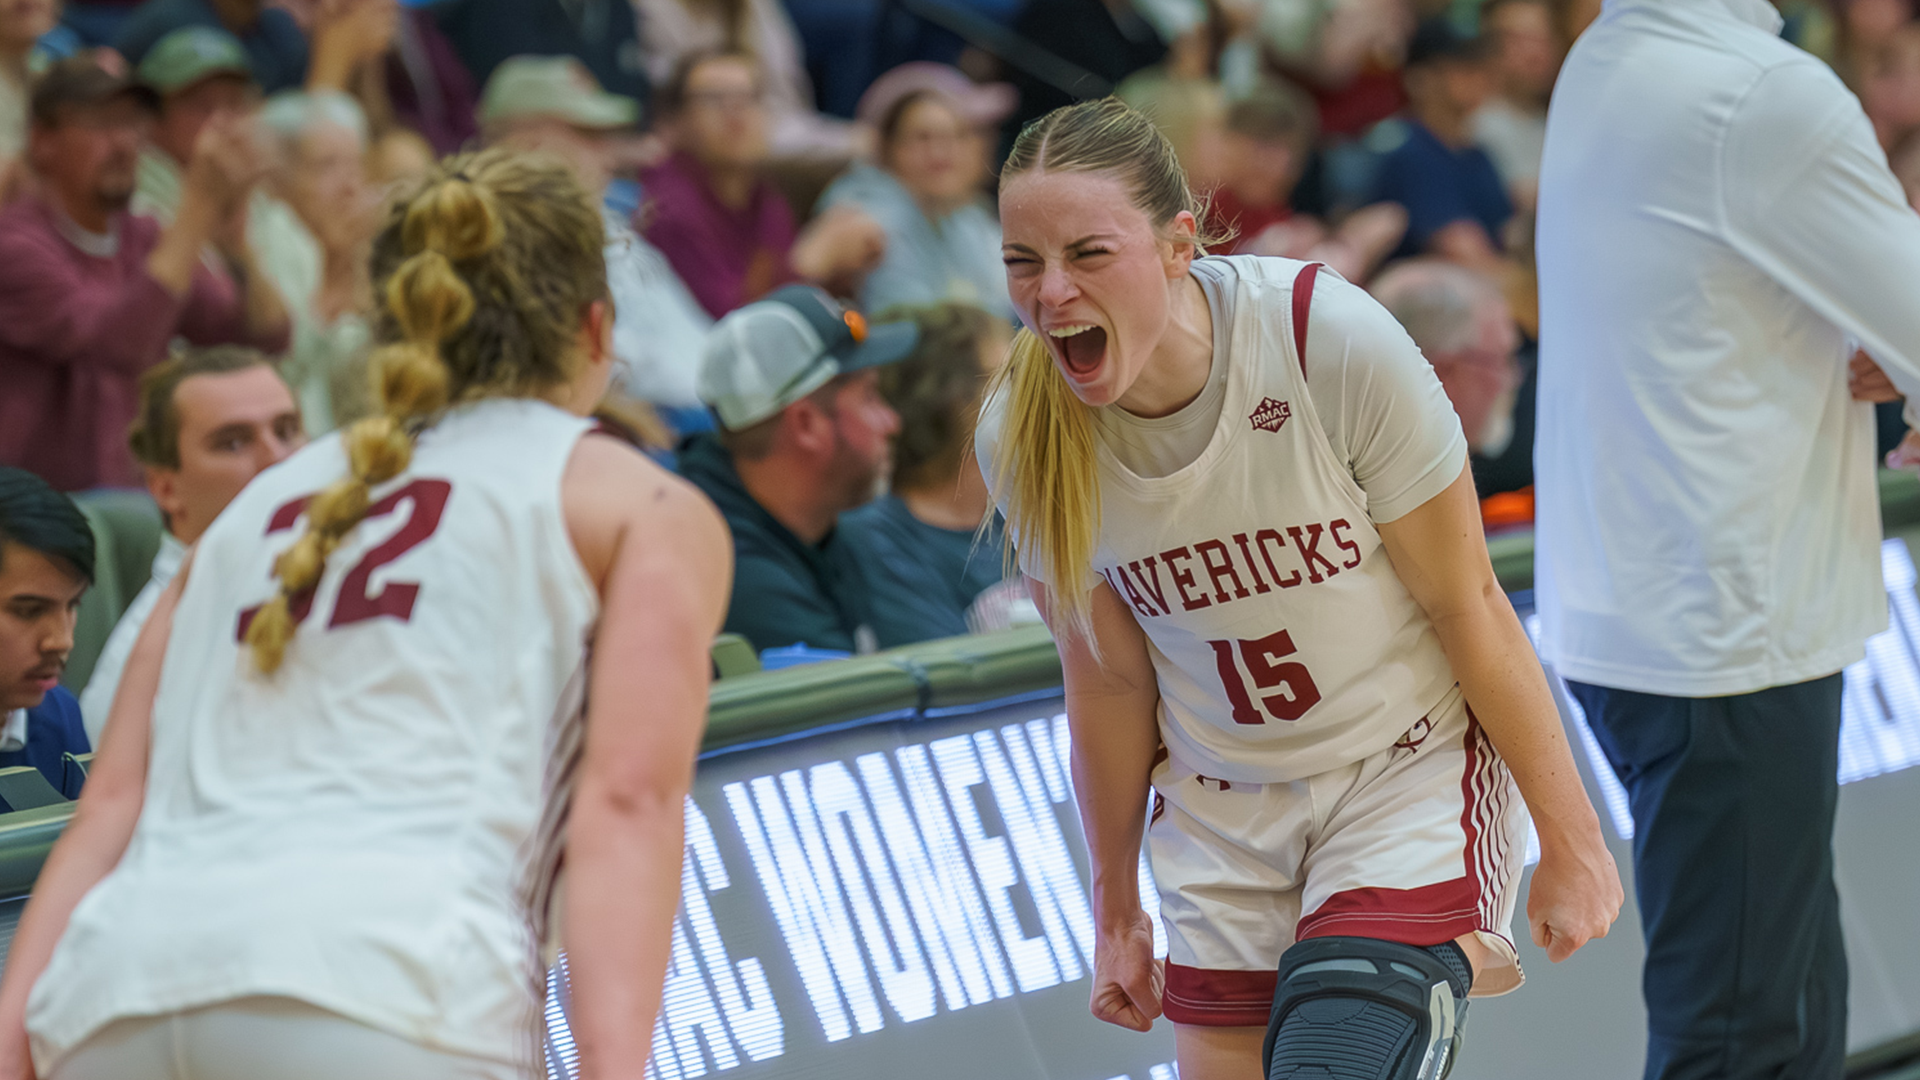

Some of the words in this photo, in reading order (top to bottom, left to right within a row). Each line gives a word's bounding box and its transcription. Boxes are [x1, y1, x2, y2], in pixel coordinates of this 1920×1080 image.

[1251, 403, 1289, 427] RMAC
[1205, 628, 1322, 725] 15
[723, 713, 1168, 1042] WOMEN'
